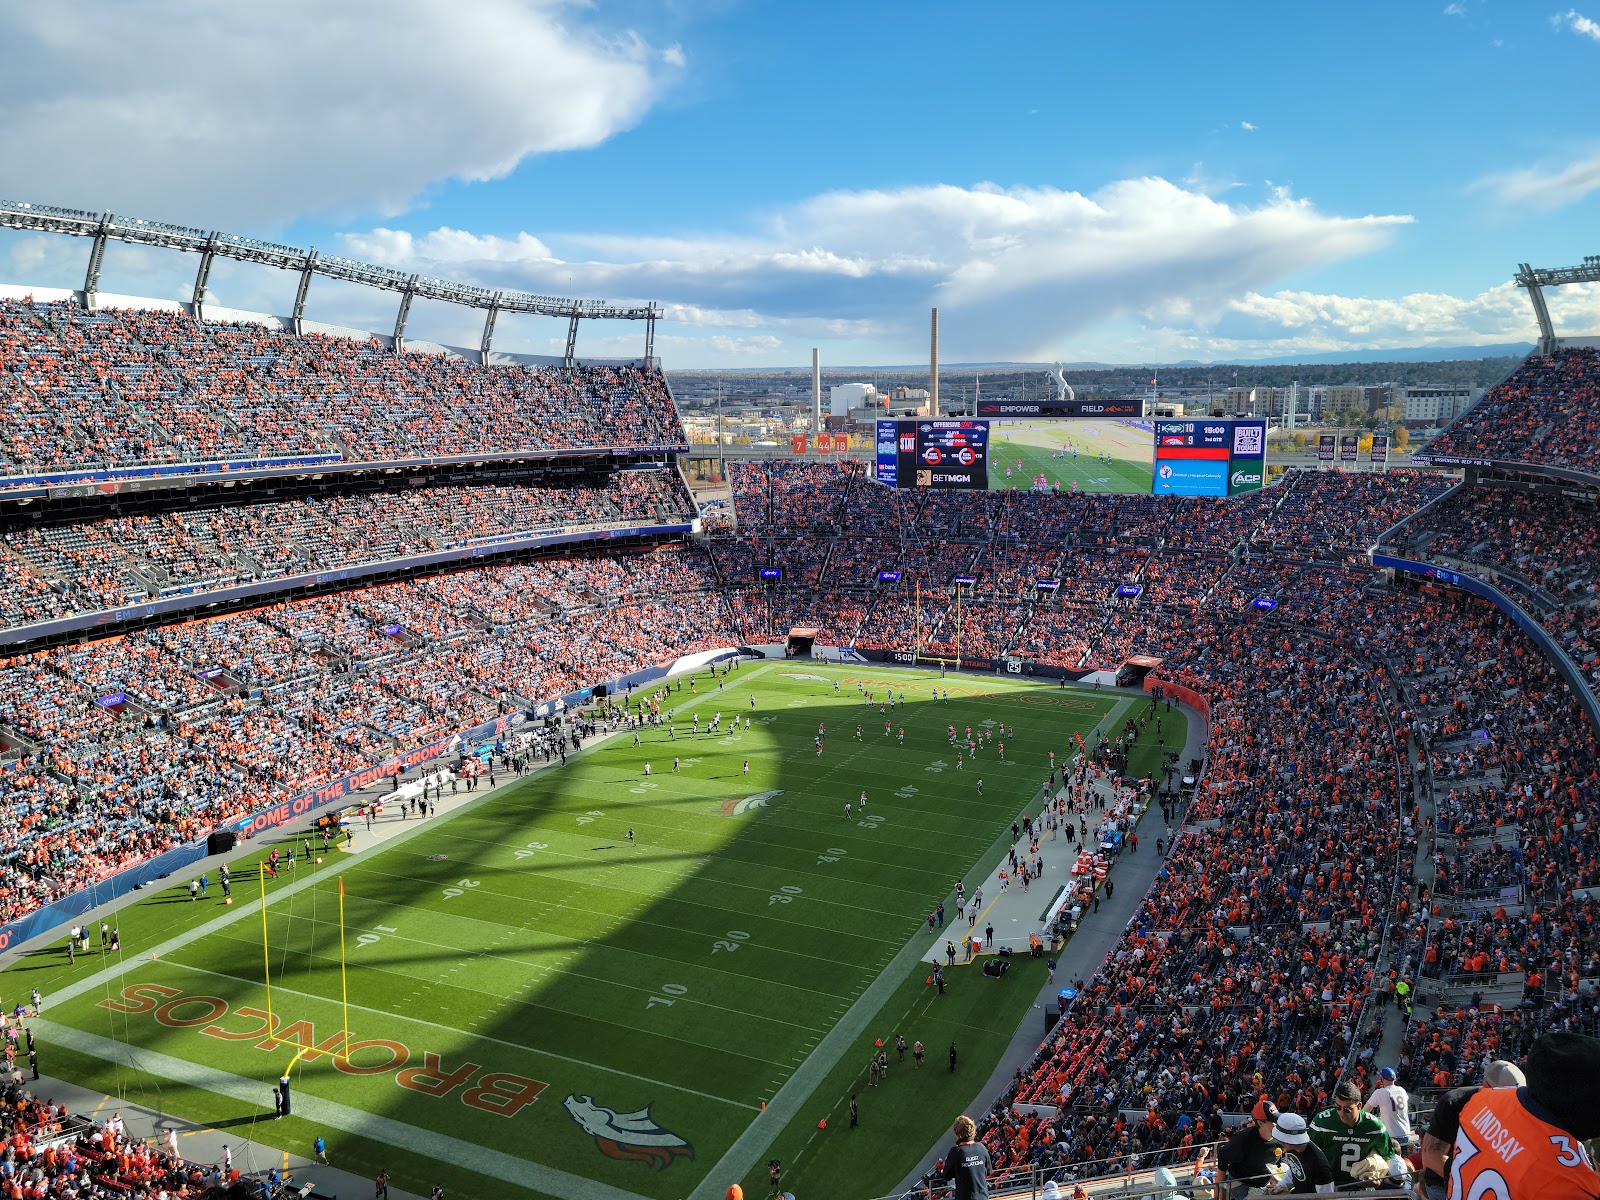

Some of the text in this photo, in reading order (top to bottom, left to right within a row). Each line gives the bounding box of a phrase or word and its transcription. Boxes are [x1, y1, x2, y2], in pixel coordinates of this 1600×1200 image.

[1000, 405, 1104, 413] EMPOWER FIELD
[1185, 423, 1195, 433] 10
[1203, 426, 1225, 434] 15:00
[1238, 428, 1260, 437] BUILT
[796, 441, 803, 451] 7
[818, 441, 830, 451] 44
[836, 441, 846, 451] 18
[900, 437, 915, 450] STAT
[1187, 435, 1194, 445] 9
[1236, 444, 1259, 452] TOUGH
[884, 463, 896, 471] bank
[932, 474, 971, 482] BETMGM
[1236, 474, 1261, 482] ACP
[87, 485, 96, 497] 10
[113, 483, 119, 493] 9
[964, 660, 991, 669] STANDS
[1009, 663, 1019, 671] 25
[102, 695, 121, 706] xfinity
[841, 677, 1098, 711] BRONCOS
[924, 760, 948, 773] 30
[629, 781, 659, 794] 50
[893, 785, 919, 799] 40
[243, 804, 290, 835] HOME
[292, 793, 313, 814] OF
[316, 781, 344, 804] THE
[349, 760, 402, 791] DENVER
[575, 809, 606, 825] 40
[856, 815, 886, 829] 50
[514, 841, 549, 858] 30
[818, 847, 848, 864] 40
[442, 878, 481, 899] 20
[770, 885, 803, 904] 30
[356, 924, 398, 944] 10
[713, 930, 751, 953] 20
[647, 983, 688, 1008] 10
[97, 983, 552, 1118] BRONCOS
[1390, 1095, 1405, 1112] 18
[1470, 1105, 1525, 1164] LINDSAY
[1340, 1143, 1361, 1173] 2
